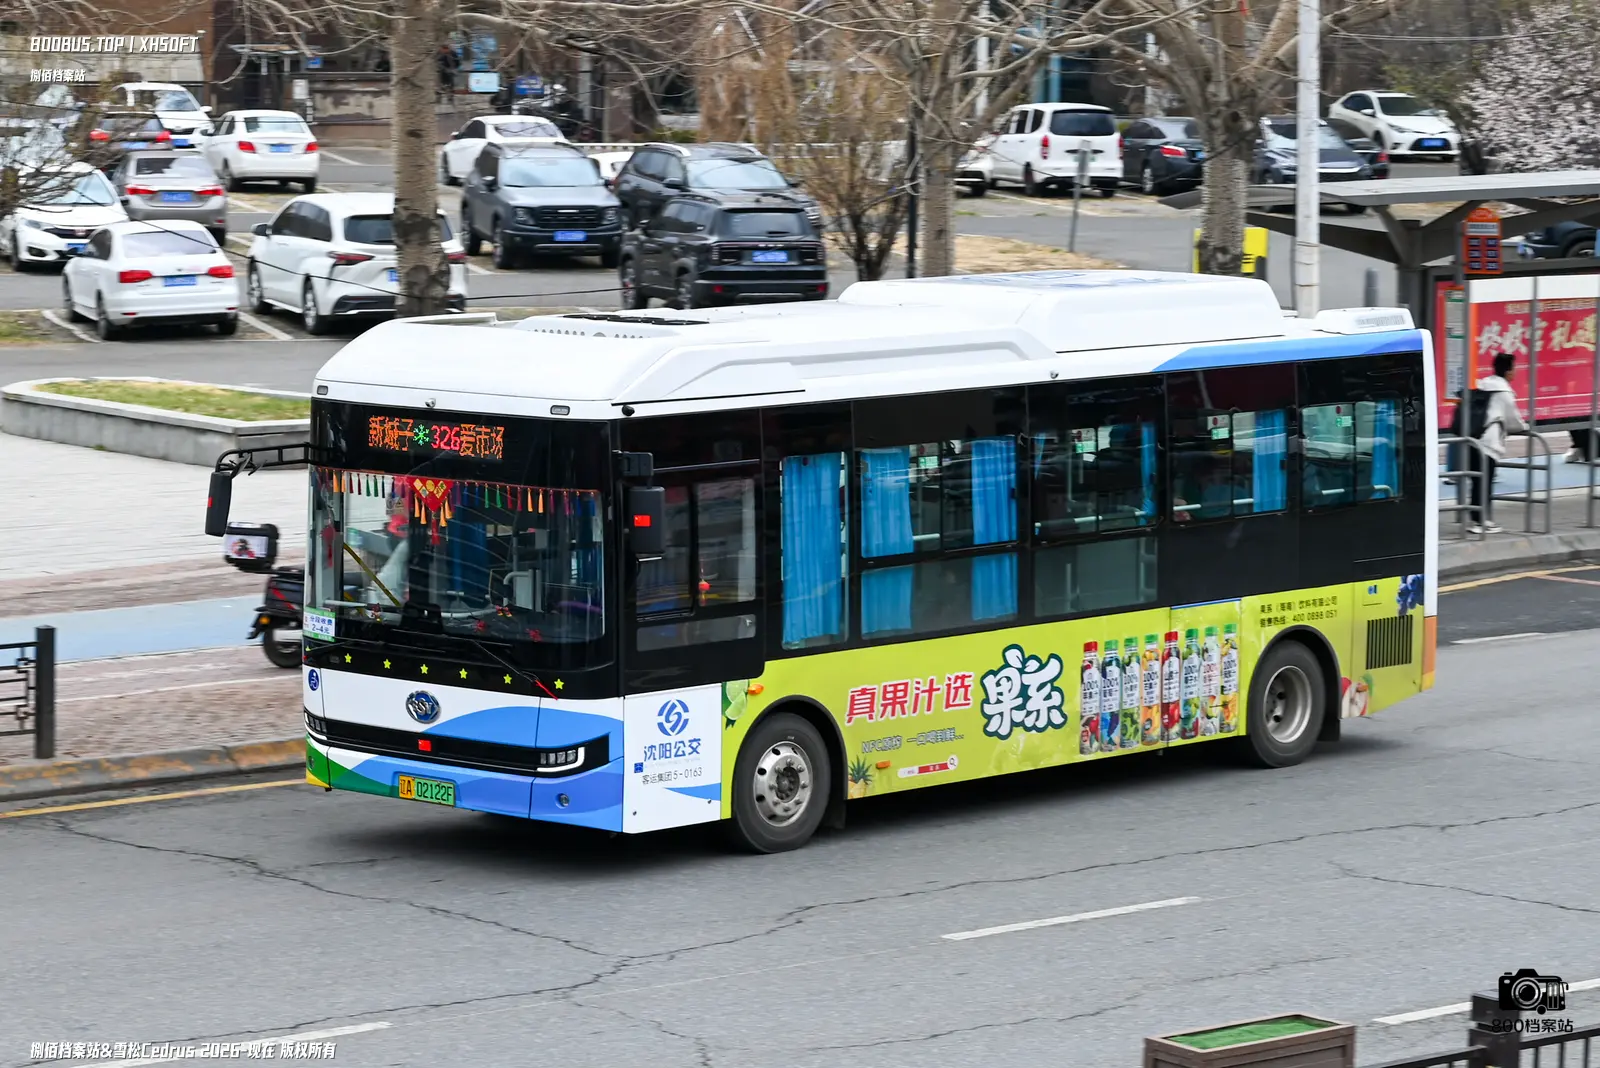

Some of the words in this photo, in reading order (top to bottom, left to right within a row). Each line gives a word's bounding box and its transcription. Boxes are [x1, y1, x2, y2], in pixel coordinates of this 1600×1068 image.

[431, 425, 460, 450] 326
[845, 673, 974, 725] 真果汁选
[981, 644, 1067, 740] 果系
[643, 738, 702, 762] 沈阳公交
